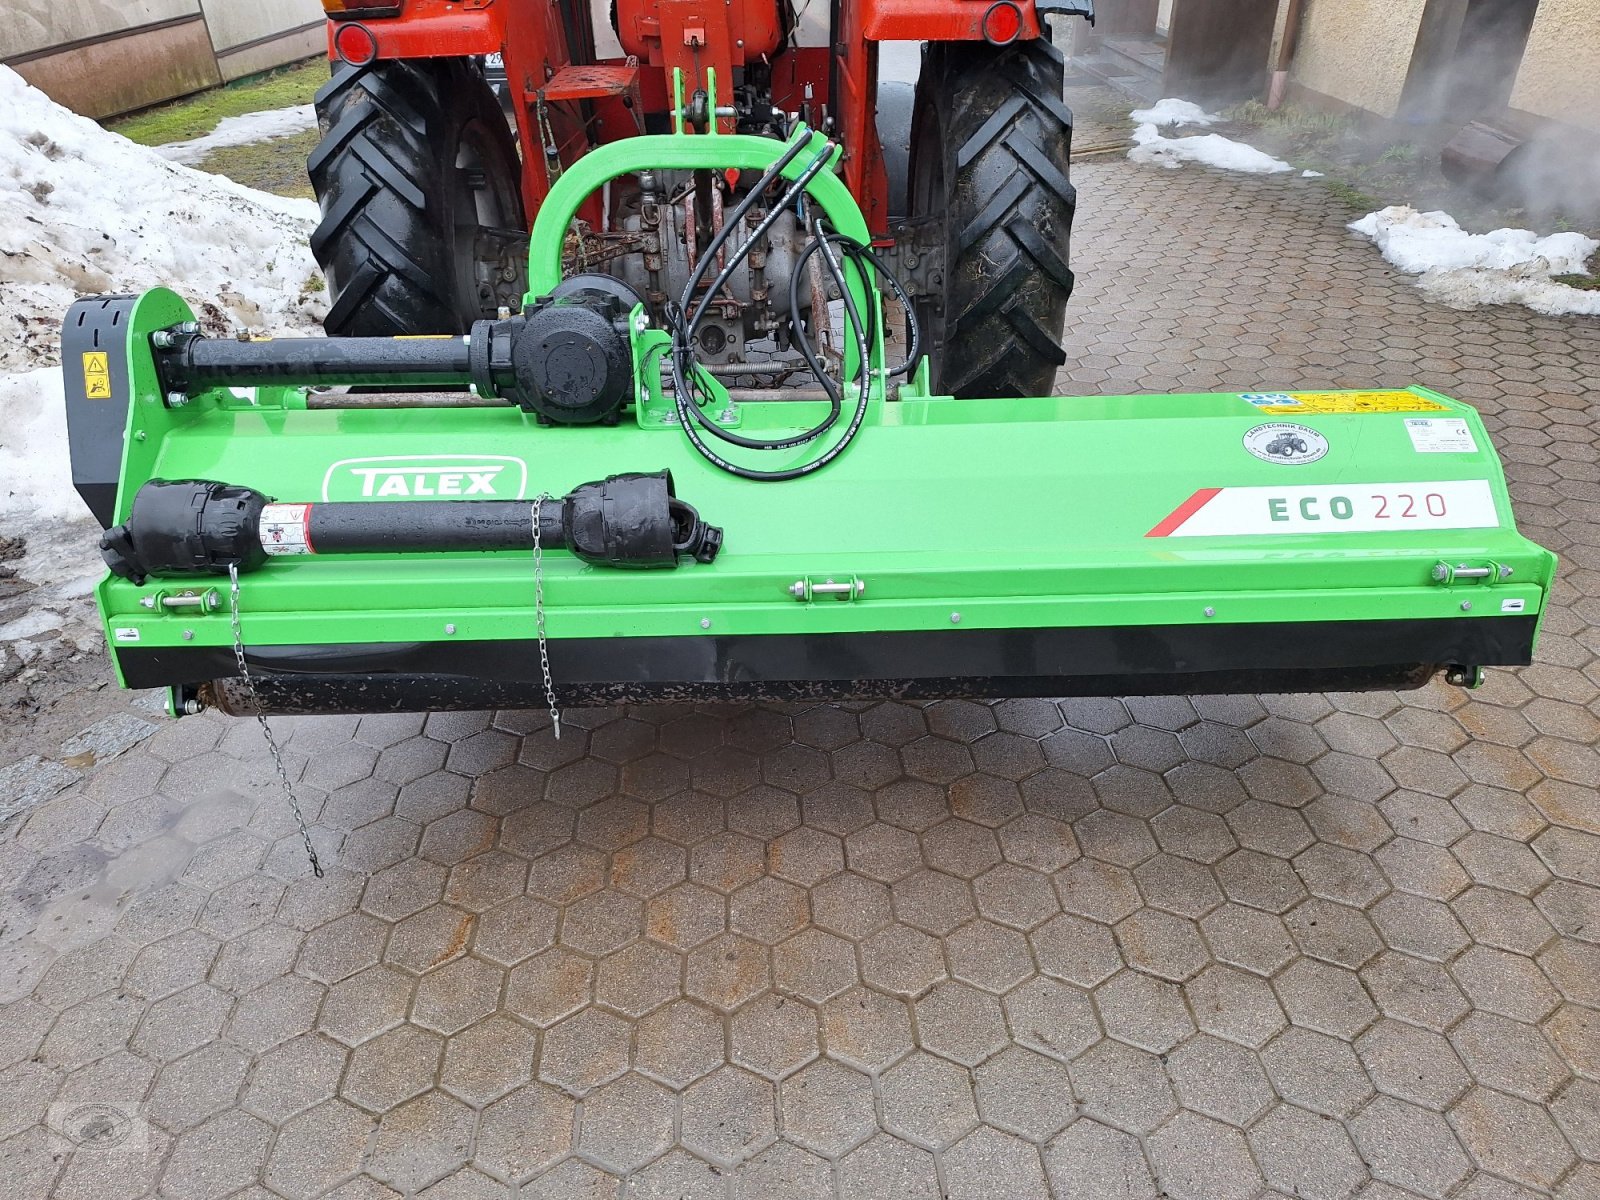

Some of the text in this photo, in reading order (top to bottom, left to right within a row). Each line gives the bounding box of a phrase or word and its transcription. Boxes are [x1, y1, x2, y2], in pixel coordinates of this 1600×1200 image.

[1247, 423, 1296, 438] LANDTECHNIK
[349, 465, 505, 497] TALEX
[1268, 493, 1447, 522] ECO 220
